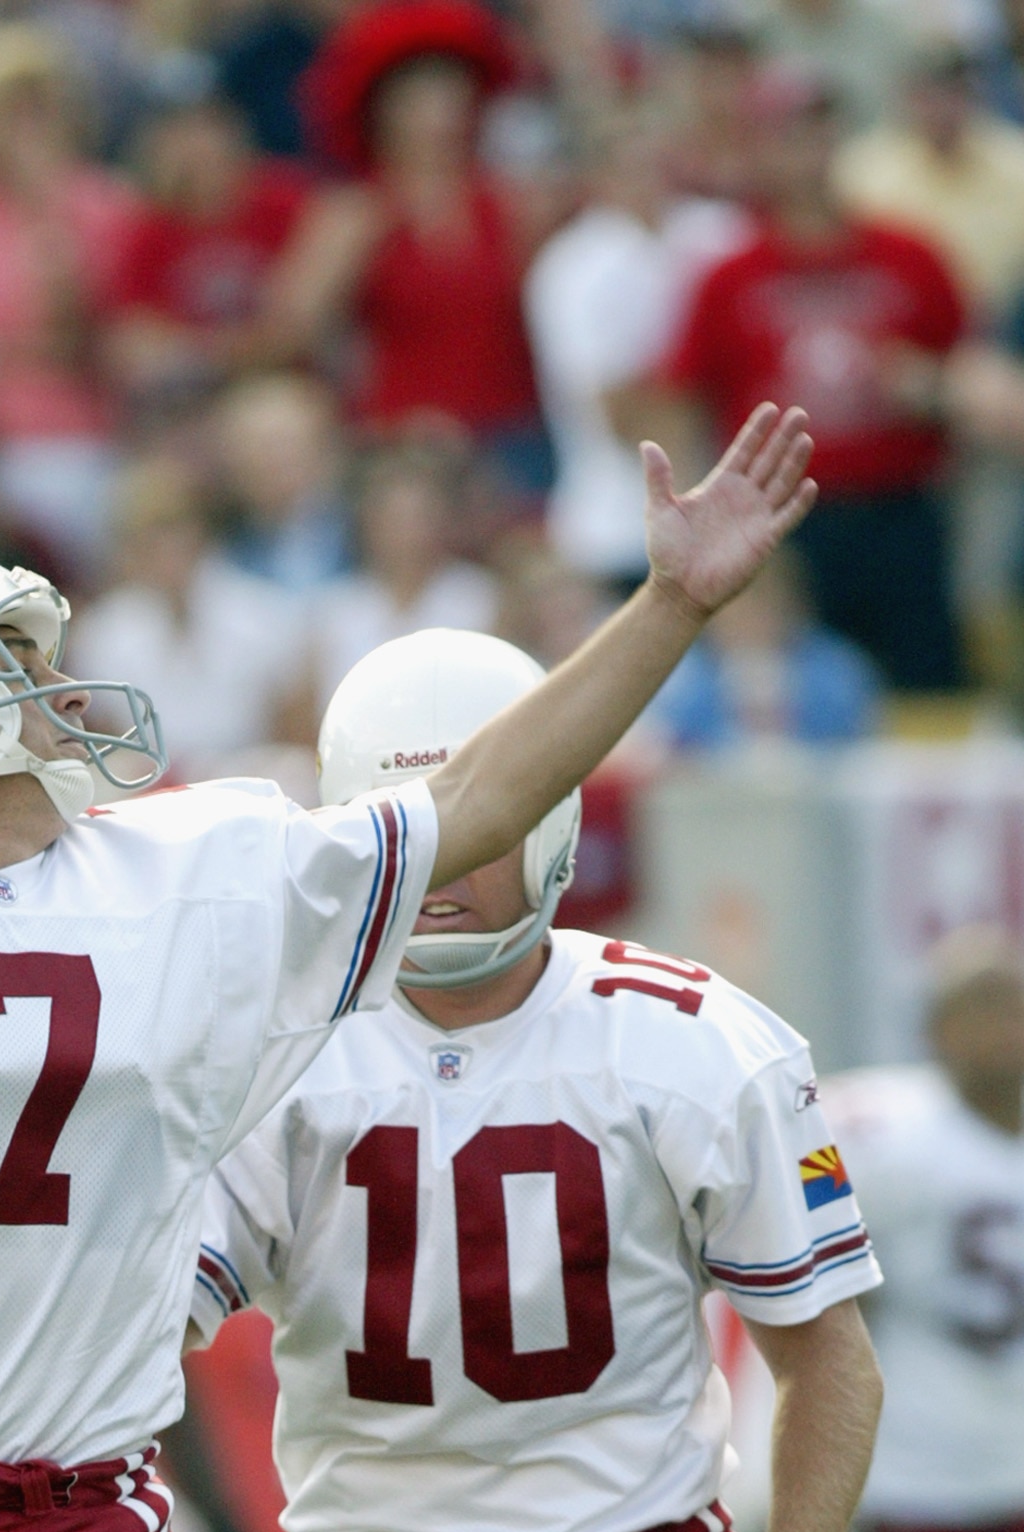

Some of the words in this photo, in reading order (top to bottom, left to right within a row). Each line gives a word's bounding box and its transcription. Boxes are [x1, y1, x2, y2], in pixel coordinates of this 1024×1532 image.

[394, 748, 447, 768] Riddell
[590, 940, 711, 1018] 10
[344, 1119, 617, 1408] 10
